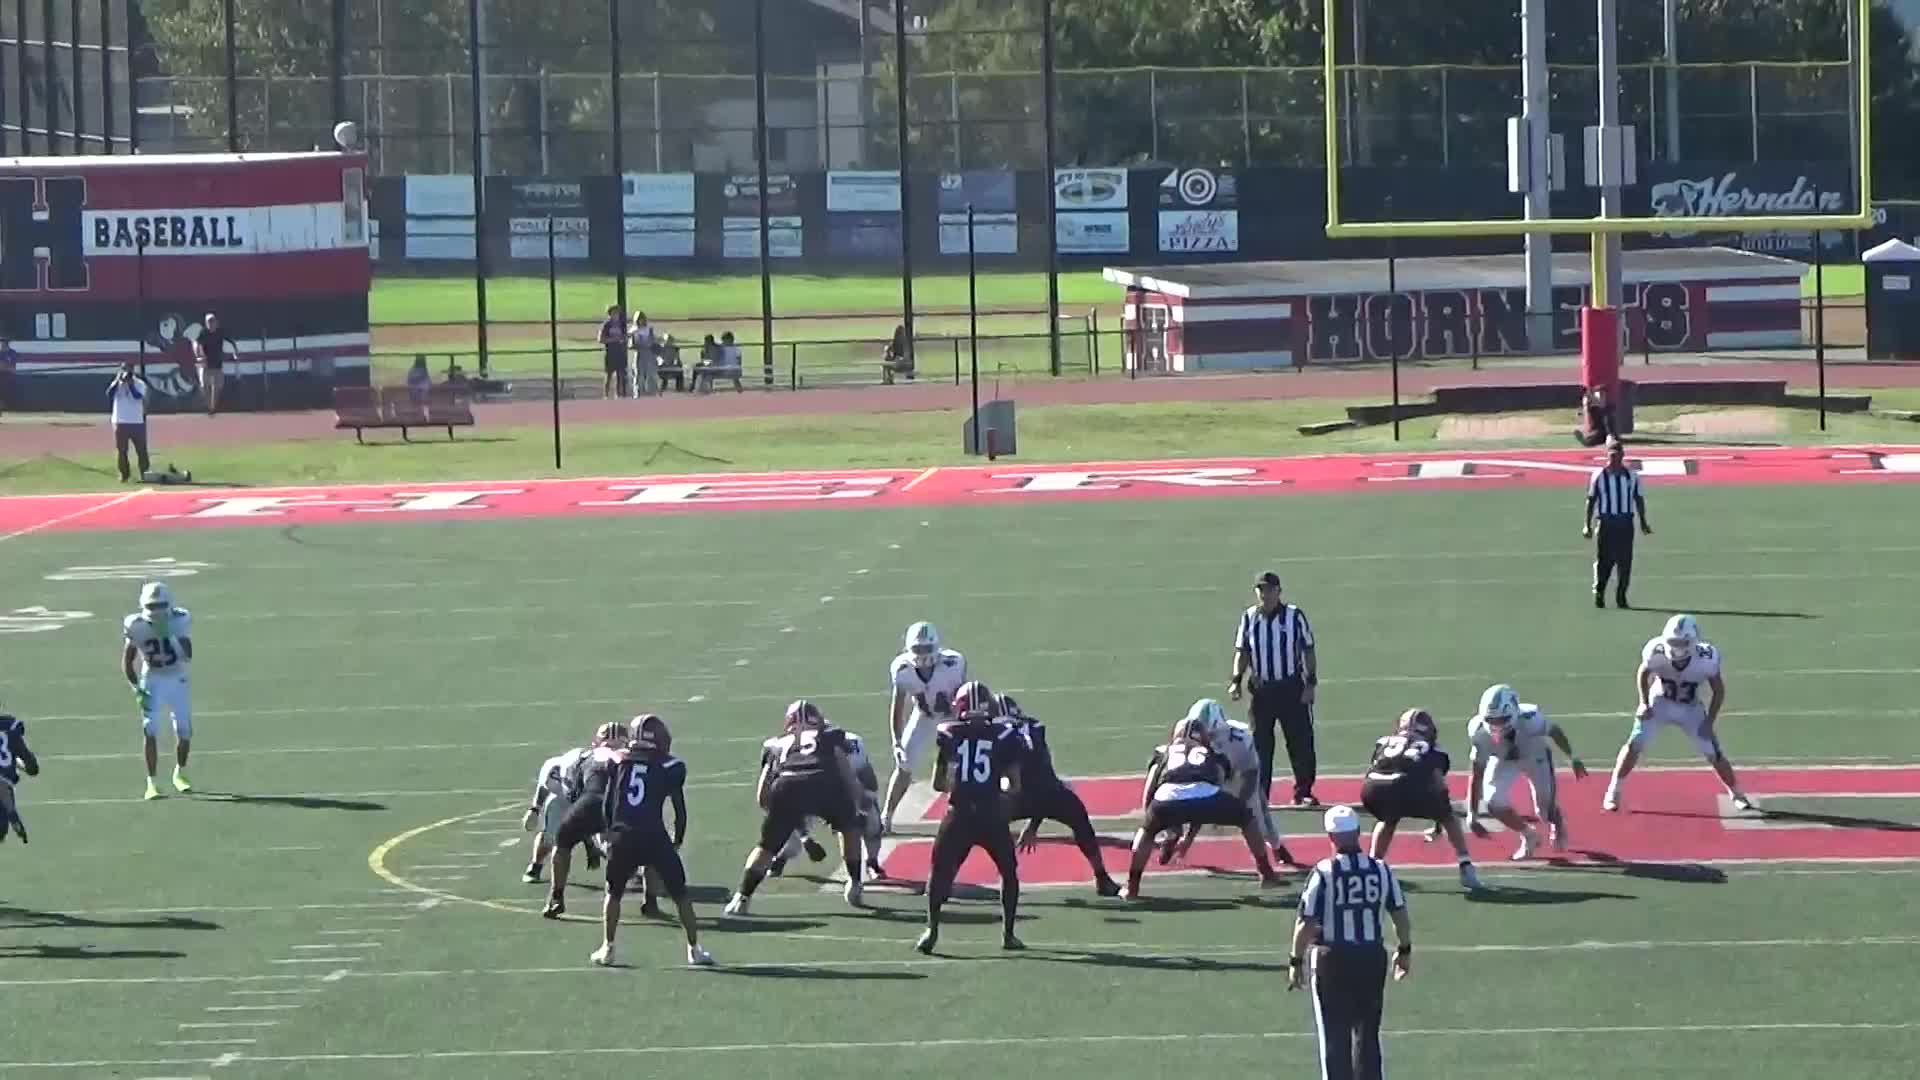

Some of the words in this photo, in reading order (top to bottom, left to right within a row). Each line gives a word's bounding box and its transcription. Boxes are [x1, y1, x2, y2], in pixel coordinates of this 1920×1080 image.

[1699, 172, 1843, 215] Herndon
[93, 214, 245, 249] BASEBALL
[1168, 236, 1229, 249] PIZZA
[956, 739, 994, 784] 15
[626, 763, 648, 807] 5
[1335, 875, 1380, 906] 126
